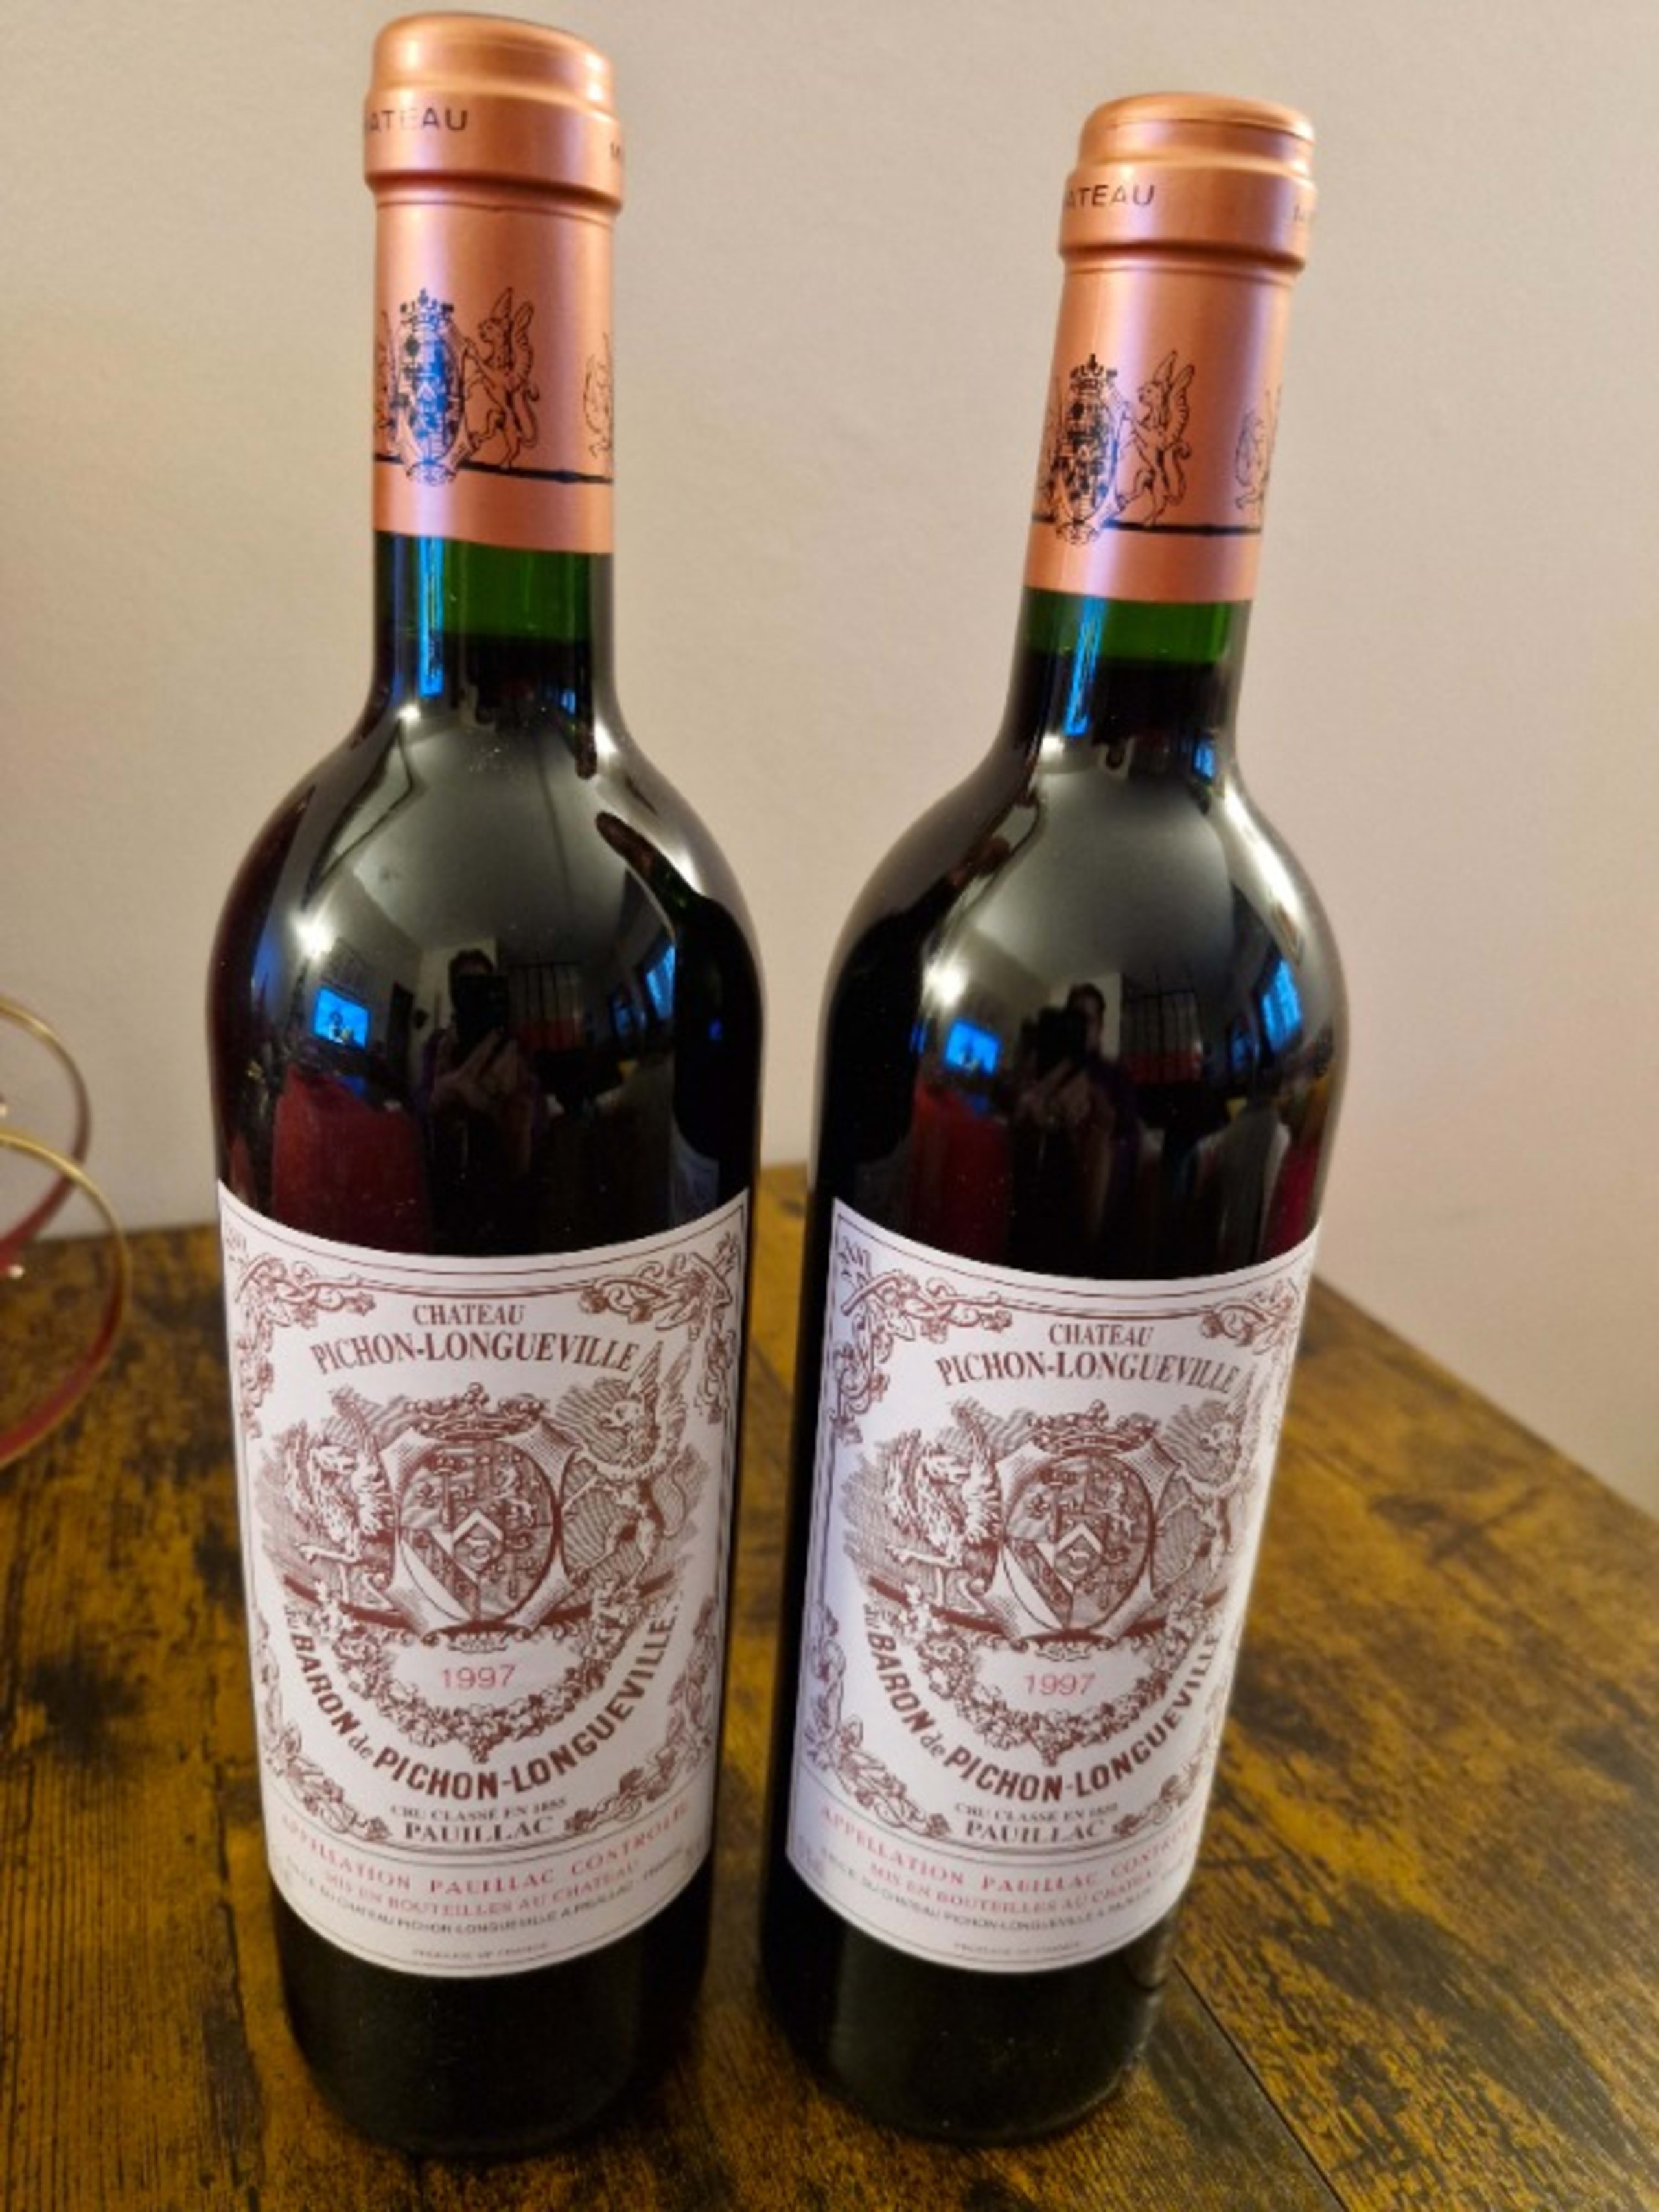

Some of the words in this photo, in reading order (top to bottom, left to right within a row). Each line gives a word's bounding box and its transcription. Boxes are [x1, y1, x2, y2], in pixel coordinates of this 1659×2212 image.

[412, 1303, 526, 1326] CHATEAU
[1047, 1323, 1154, 1346] CHATEAU
[310, 1331, 640, 1375] PICHON-LONGUEVILLE
[935, 1351, 1240, 1395] PICHON-LONGUEVILLE
[442, 1663, 517, 1690] 1997
[1023, 1672, 1097, 1696] 1997
[290, 1633, 361, 1735] BARON
[348, 1733, 374, 1760] de
[868, 1632, 936, 1734] BARON
[920, 1733, 946, 1758] de
[405, 1815, 554, 1843] PAUILLAC
[966, 1818, 1106, 1843] PAUILLAC
[430, 1870, 553, 1895] PAUILLAC
[981, 1872, 1097, 1893] PAUILLAC
